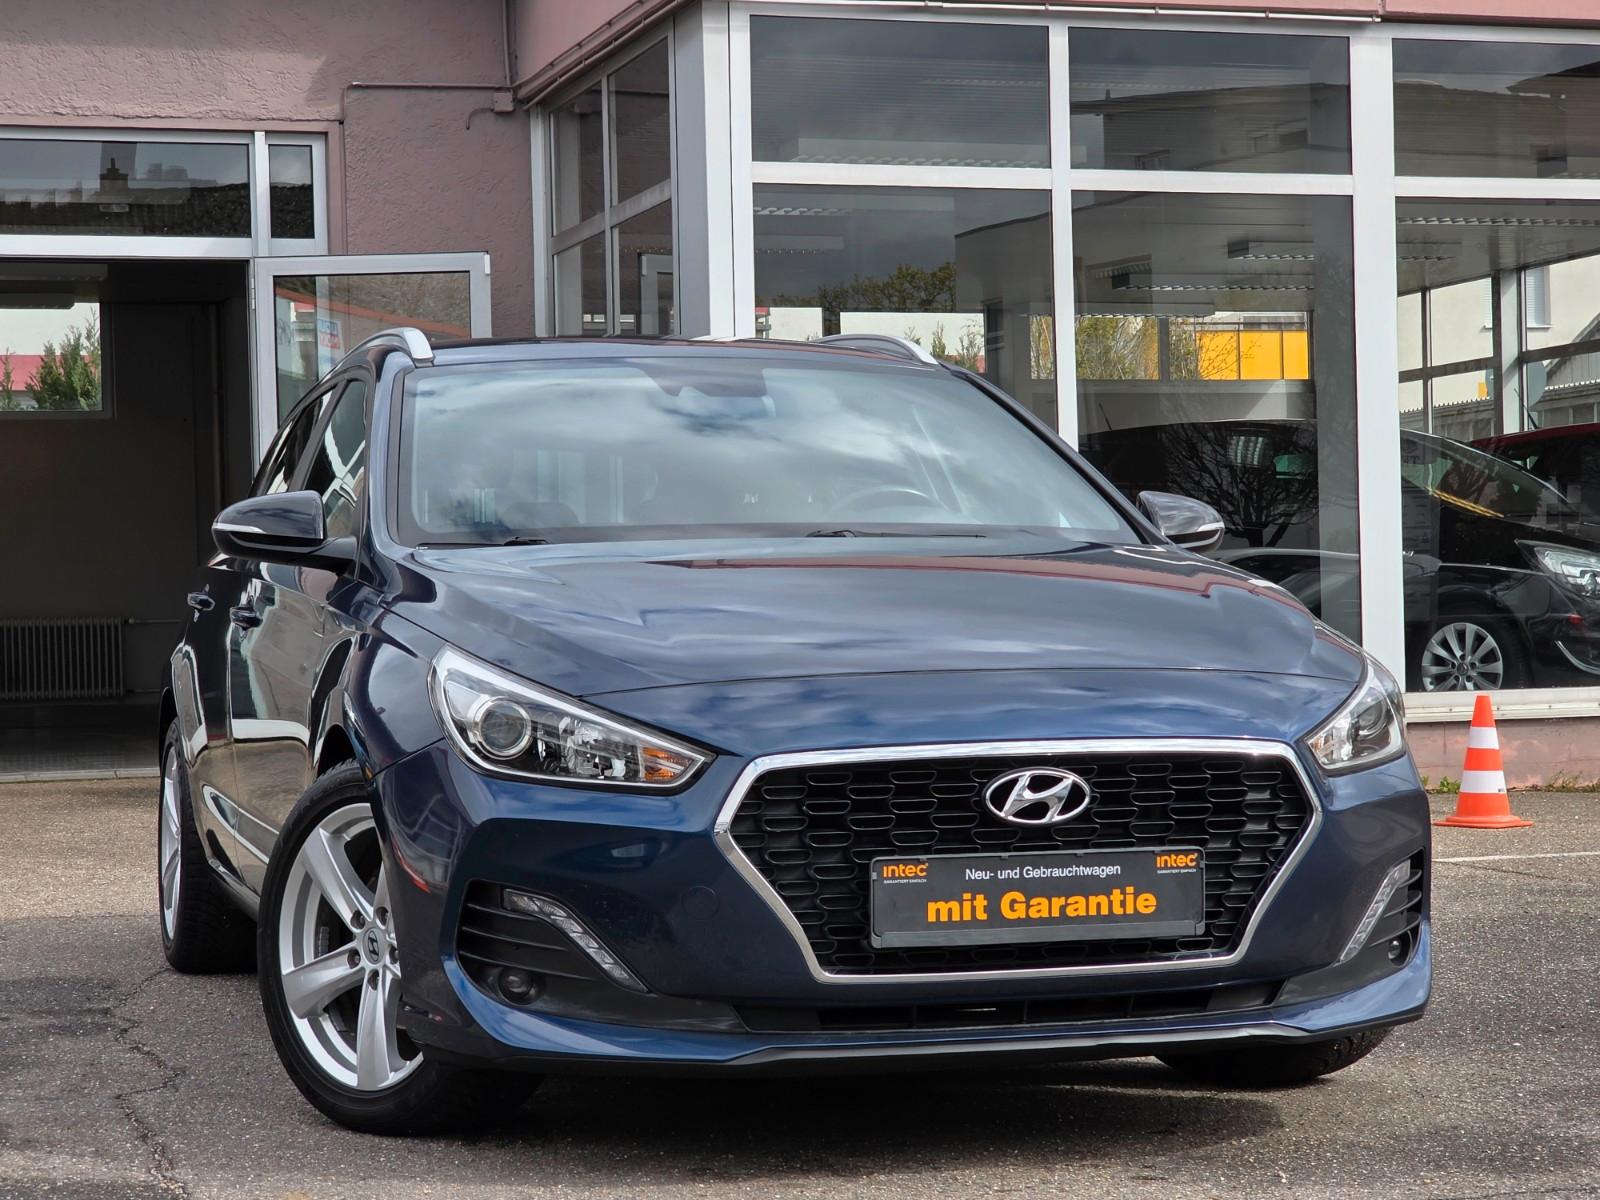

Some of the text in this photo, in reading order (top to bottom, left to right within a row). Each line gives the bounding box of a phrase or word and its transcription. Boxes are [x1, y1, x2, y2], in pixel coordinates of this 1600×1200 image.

[1156, 853, 1198, 868] intec
[883, 863, 928, 878] intec
[965, 864, 1121, 880] Neu- und Gebrauchtwagen
[927, 886, 1157, 922] mit Garantie
